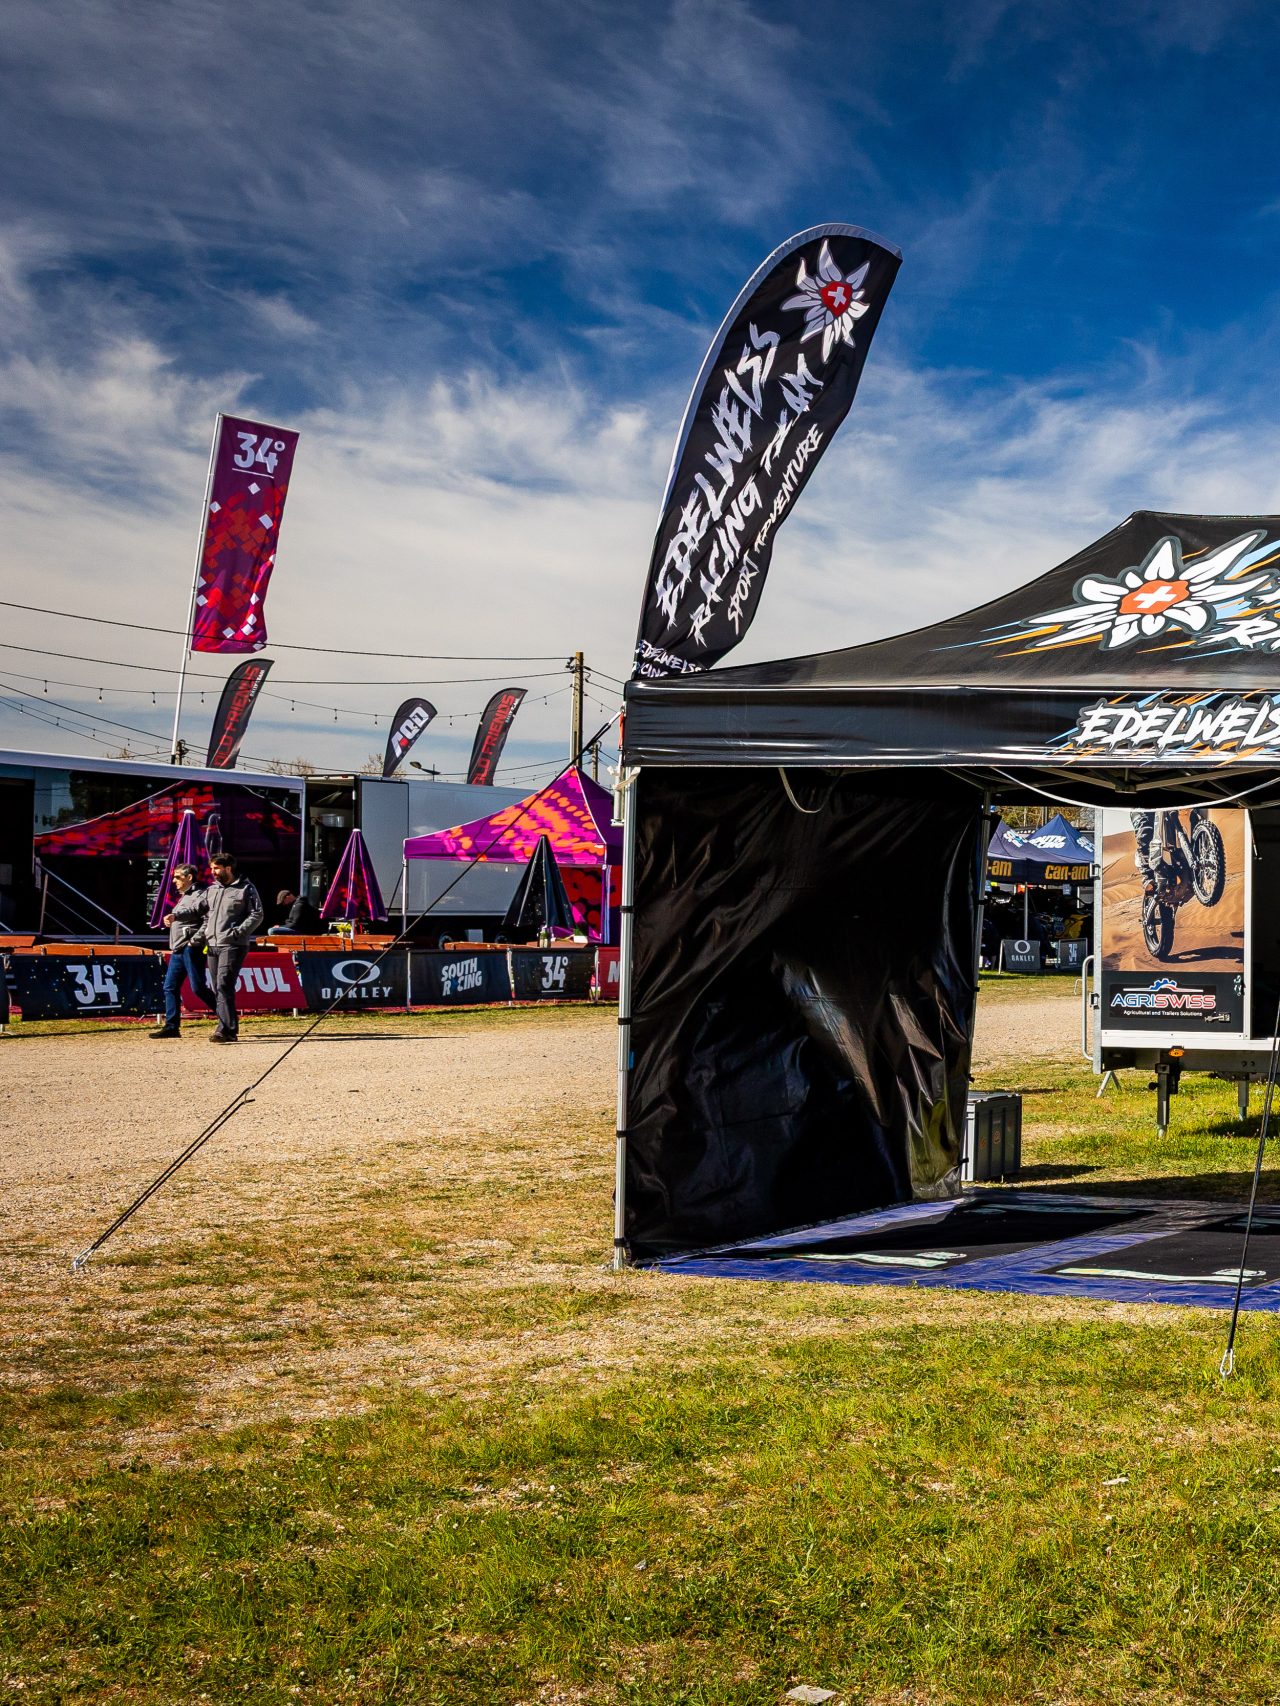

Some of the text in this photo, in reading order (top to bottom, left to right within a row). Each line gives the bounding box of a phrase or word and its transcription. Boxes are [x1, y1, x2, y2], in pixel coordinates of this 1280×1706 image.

[656, 321, 781, 631] EDELWEISS
[687, 473, 763, 647] RACING
[728, 423, 824, 636] SPORT ADVENTURE
[224, 665, 260, 732] FRIENDS
[482, 693, 517, 756] FRIENDS
[441, 957, 478, 980] SOUTH
[1011, 954, 1035, 962] OAKLEY
[321, 986, 392, 999] OAKLEY
[1111, 993, 1216, 1010] AGRISWISS
